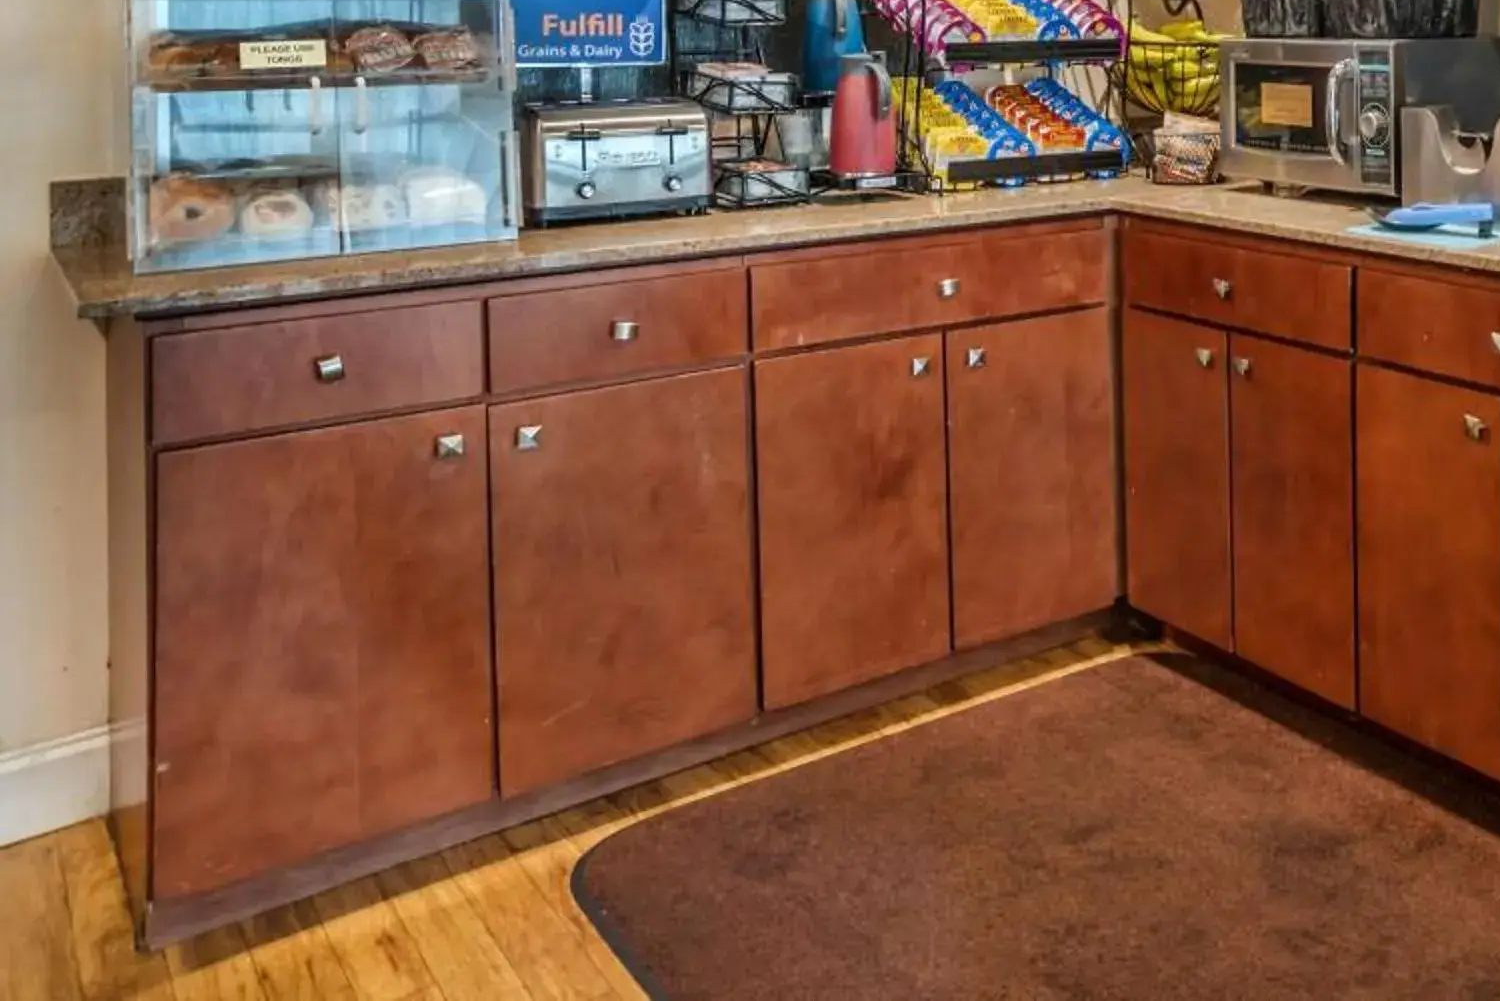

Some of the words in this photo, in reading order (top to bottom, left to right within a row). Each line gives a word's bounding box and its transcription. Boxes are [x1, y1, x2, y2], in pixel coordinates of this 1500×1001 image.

[543, 12, 623, 37] Fulfill
[517, 44, 567, 57] Grains
[569, 45, 581, 57] &
[584, 44, 623, 59] Dairy
